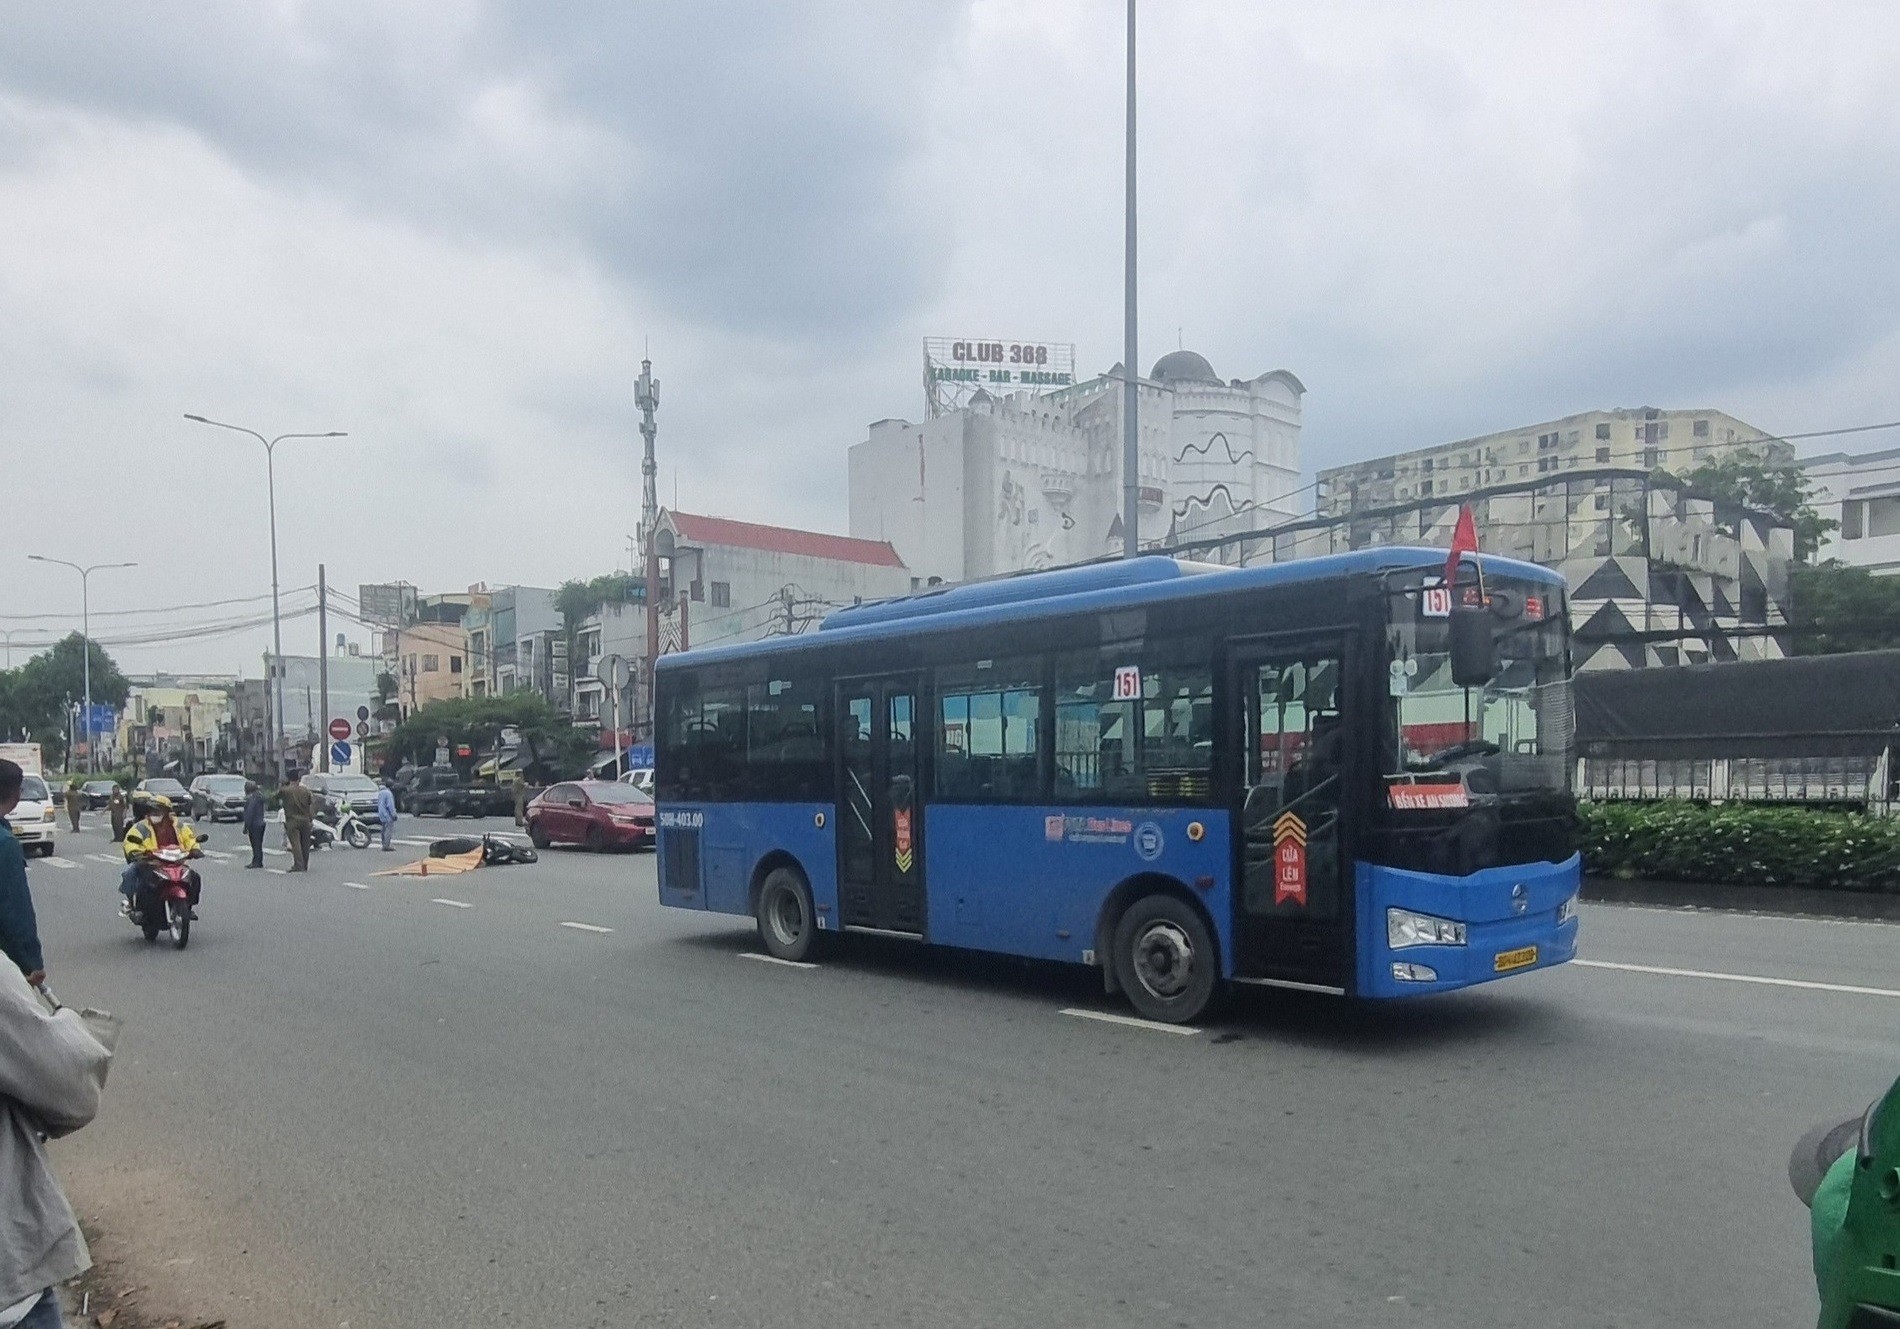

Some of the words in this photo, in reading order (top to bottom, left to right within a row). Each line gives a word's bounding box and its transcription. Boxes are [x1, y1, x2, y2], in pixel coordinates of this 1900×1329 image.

[952, 342, 1004, 362] CLUB
[1010, 344, 1047, 364] 368
[930, 366, 980, 382] KARAOKE
[989, 369, 1011, 383] BAR
[1020, 371, 1071, 385] MASSAGE
[1117, 672, 1137, 696] 151
